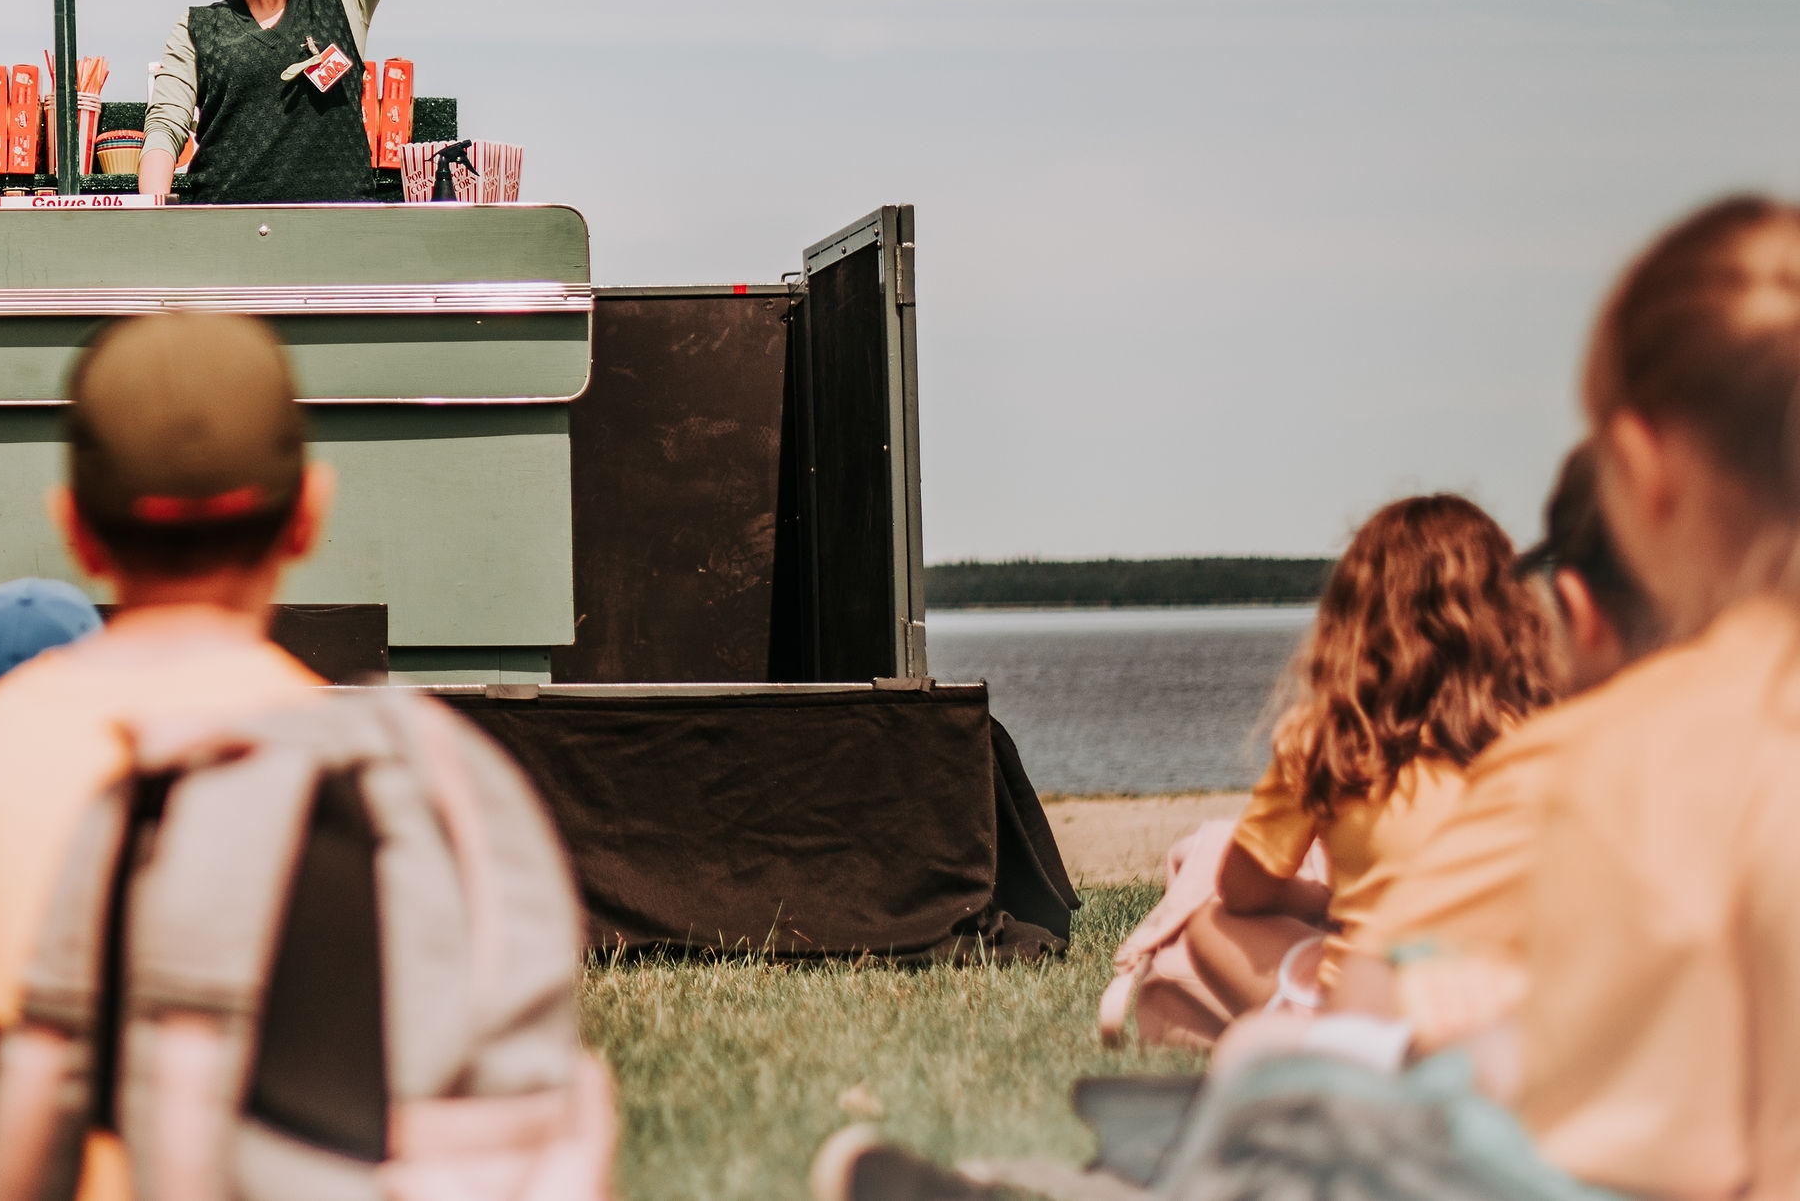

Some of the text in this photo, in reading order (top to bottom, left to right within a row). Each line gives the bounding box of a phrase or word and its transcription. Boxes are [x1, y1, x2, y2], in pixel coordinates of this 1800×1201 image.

[317, 60, 345, 86] 606
[406, 170, 423, 184] POP
[484, 167, 493, 178] POP
[505, 171, 514, 183] POP
[453, 176, 477, 193] CORN
[92, 195, 123, 207] 606
